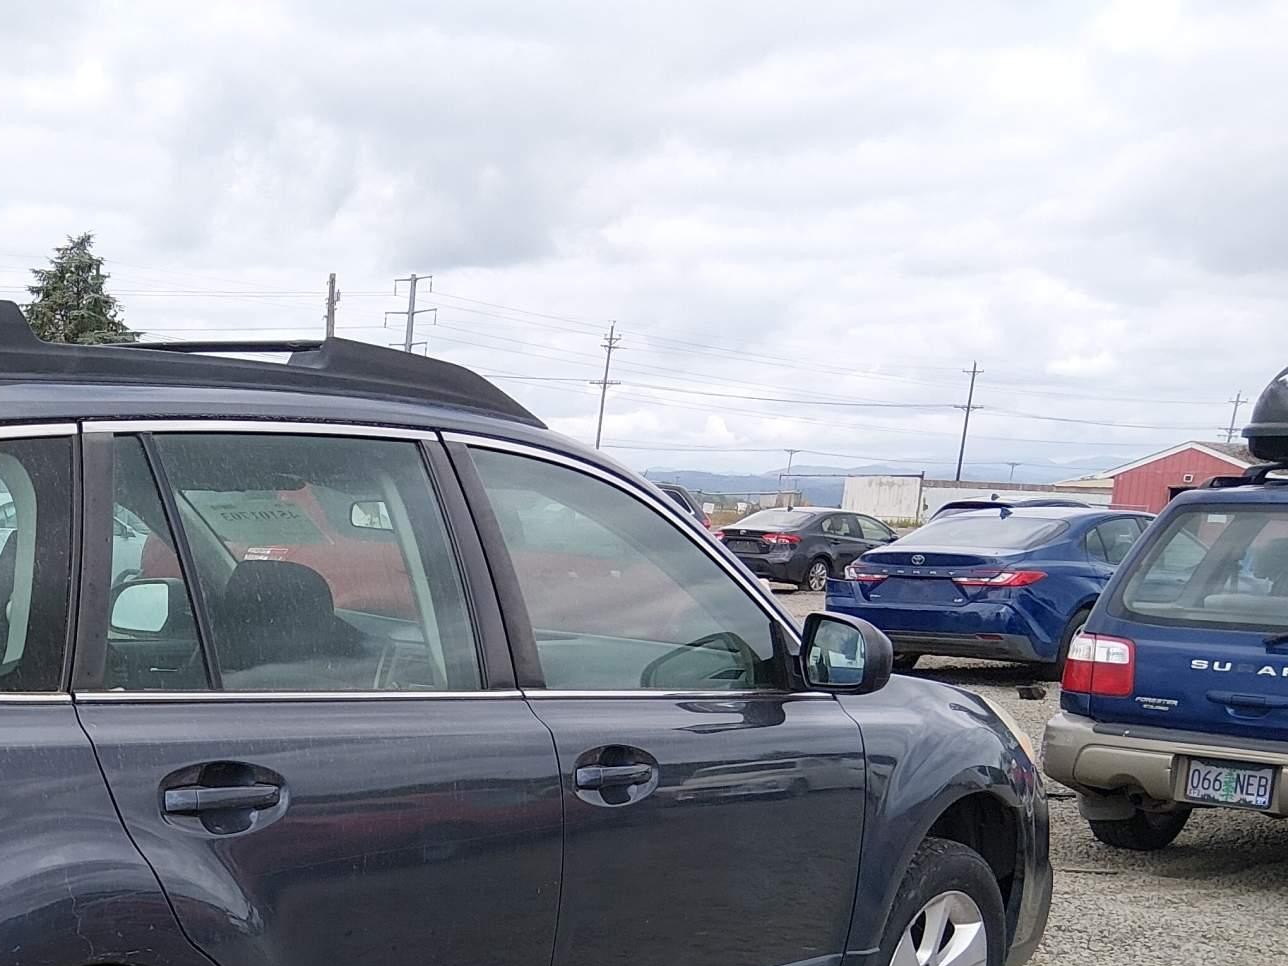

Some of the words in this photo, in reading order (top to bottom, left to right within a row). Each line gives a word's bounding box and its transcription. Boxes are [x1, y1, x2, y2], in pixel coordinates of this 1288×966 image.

[1191, 659, 1288, 677] SUA
[1191, 769, 1223, 791] 066
[1234, 773, 1268, 796] NEB
